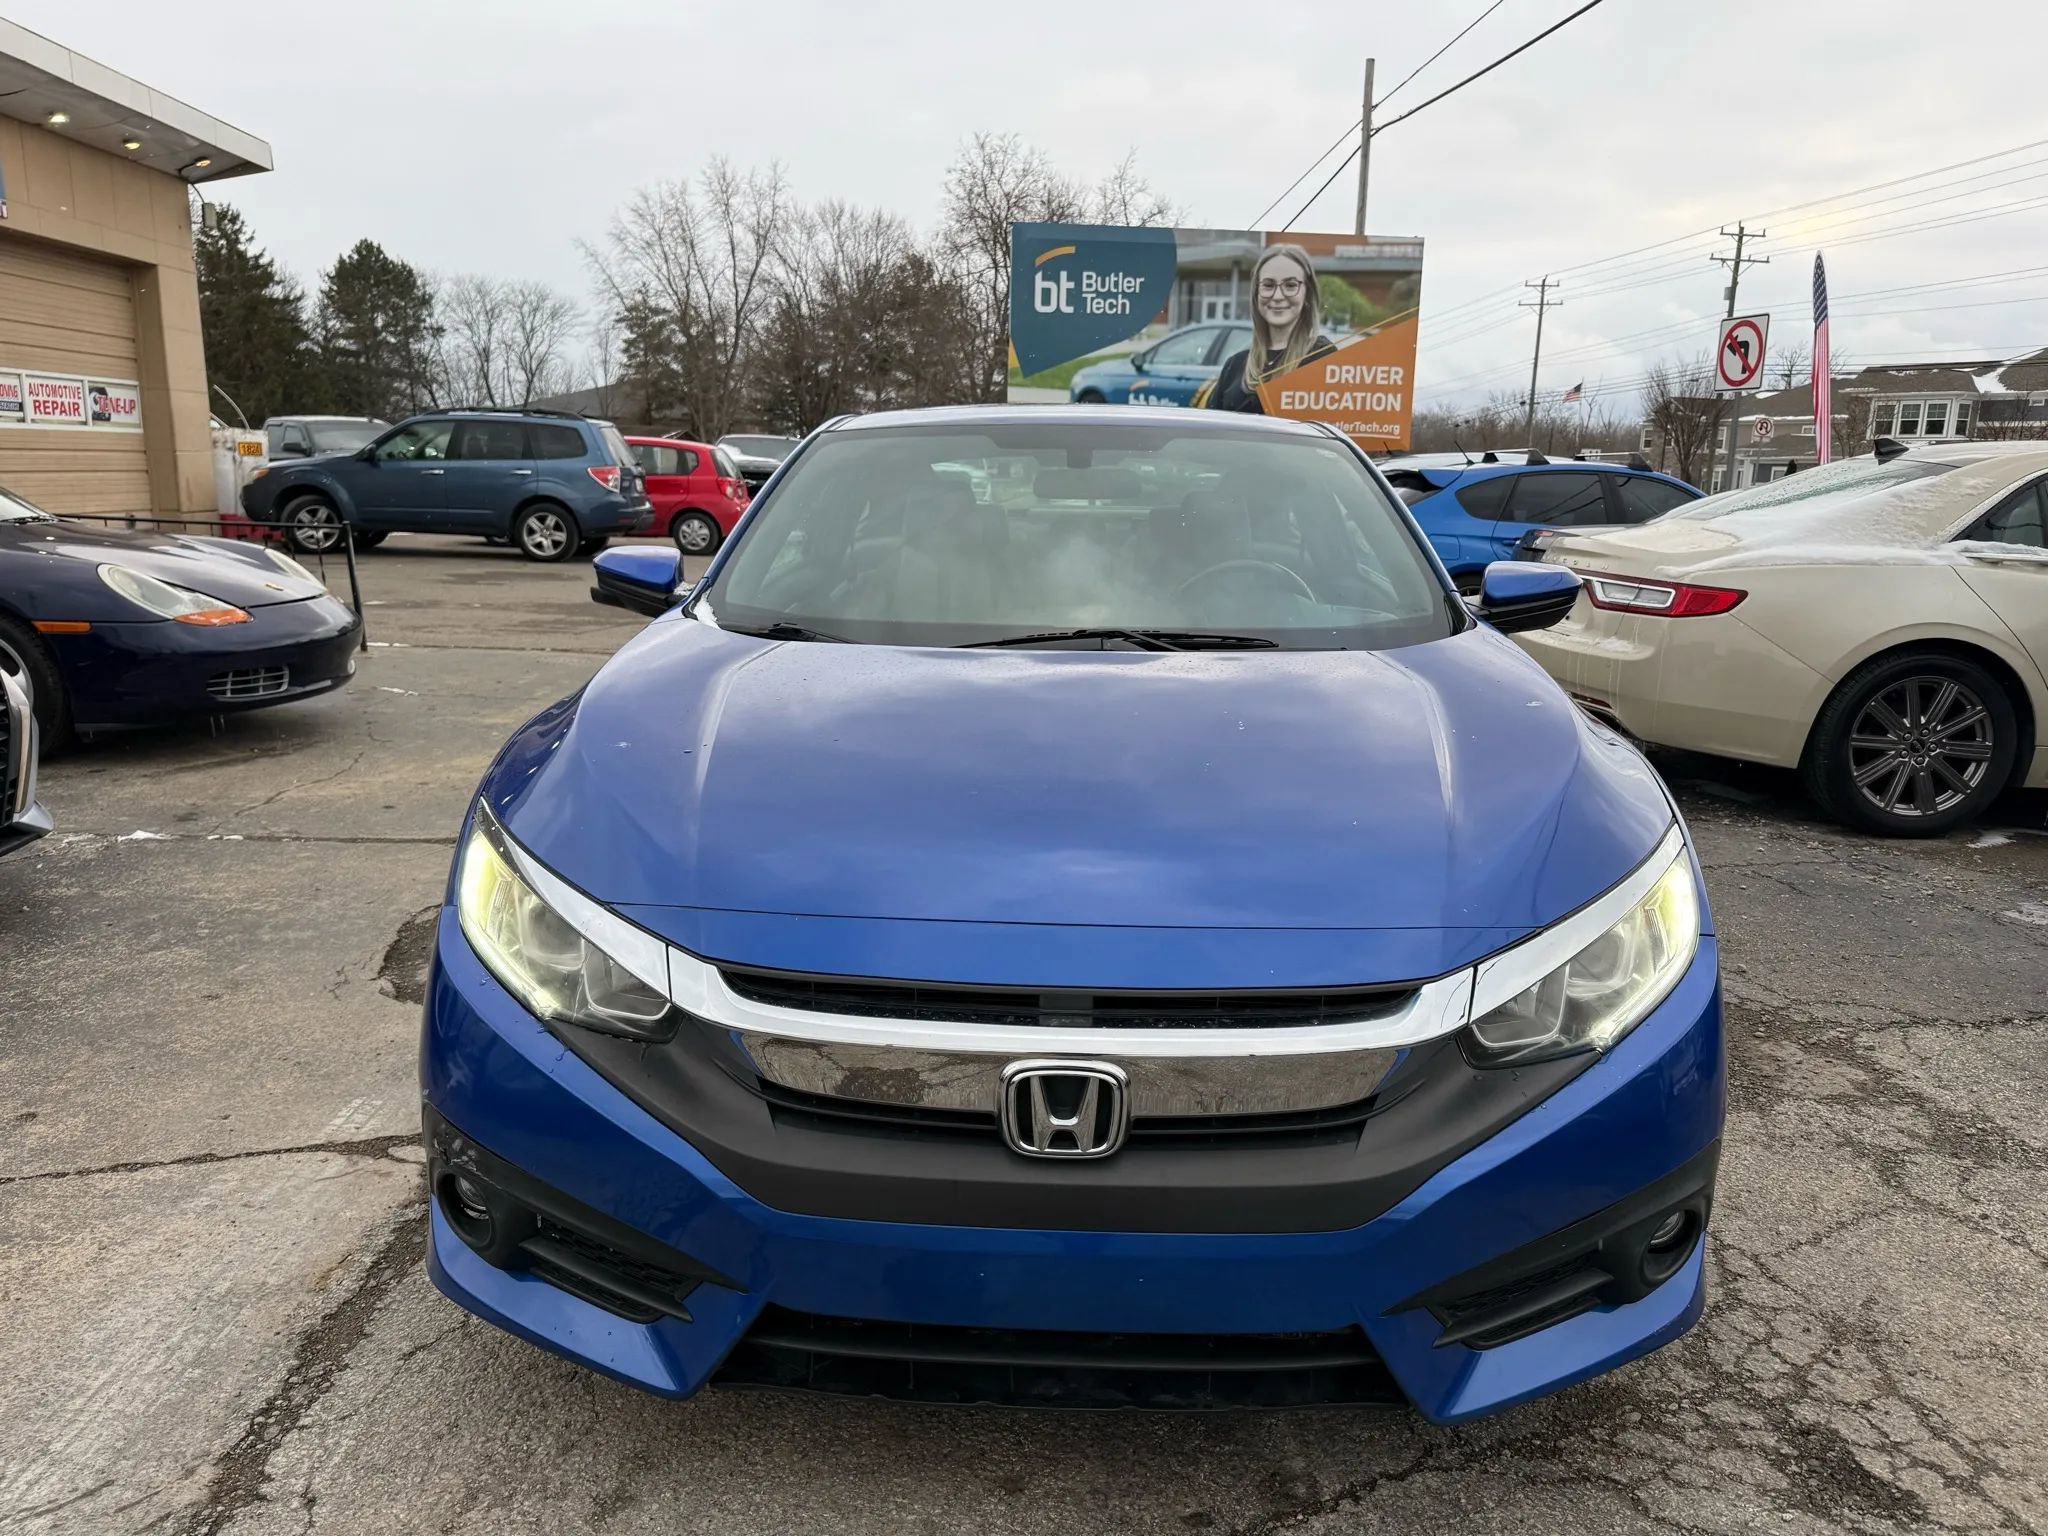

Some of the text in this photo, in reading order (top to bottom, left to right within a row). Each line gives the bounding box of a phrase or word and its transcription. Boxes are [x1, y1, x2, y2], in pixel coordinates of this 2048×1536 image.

[1034, 269, 1075, 313] bt
[1081, 271, 1145, 293] Butler
[1081, 293, 1130, 315] Tech
[1325, 364, 1404, 385] DRIVER
[28, 382, 82, 400] AUTOMOTIVE
[1280, 390, 1401, 412] EDUCATION
[32, 399, 82, 417] REPAIR
[96, 396, 136, 414] TUNE-UP
[1330, 420, 1401, 436] tlerTech.org
